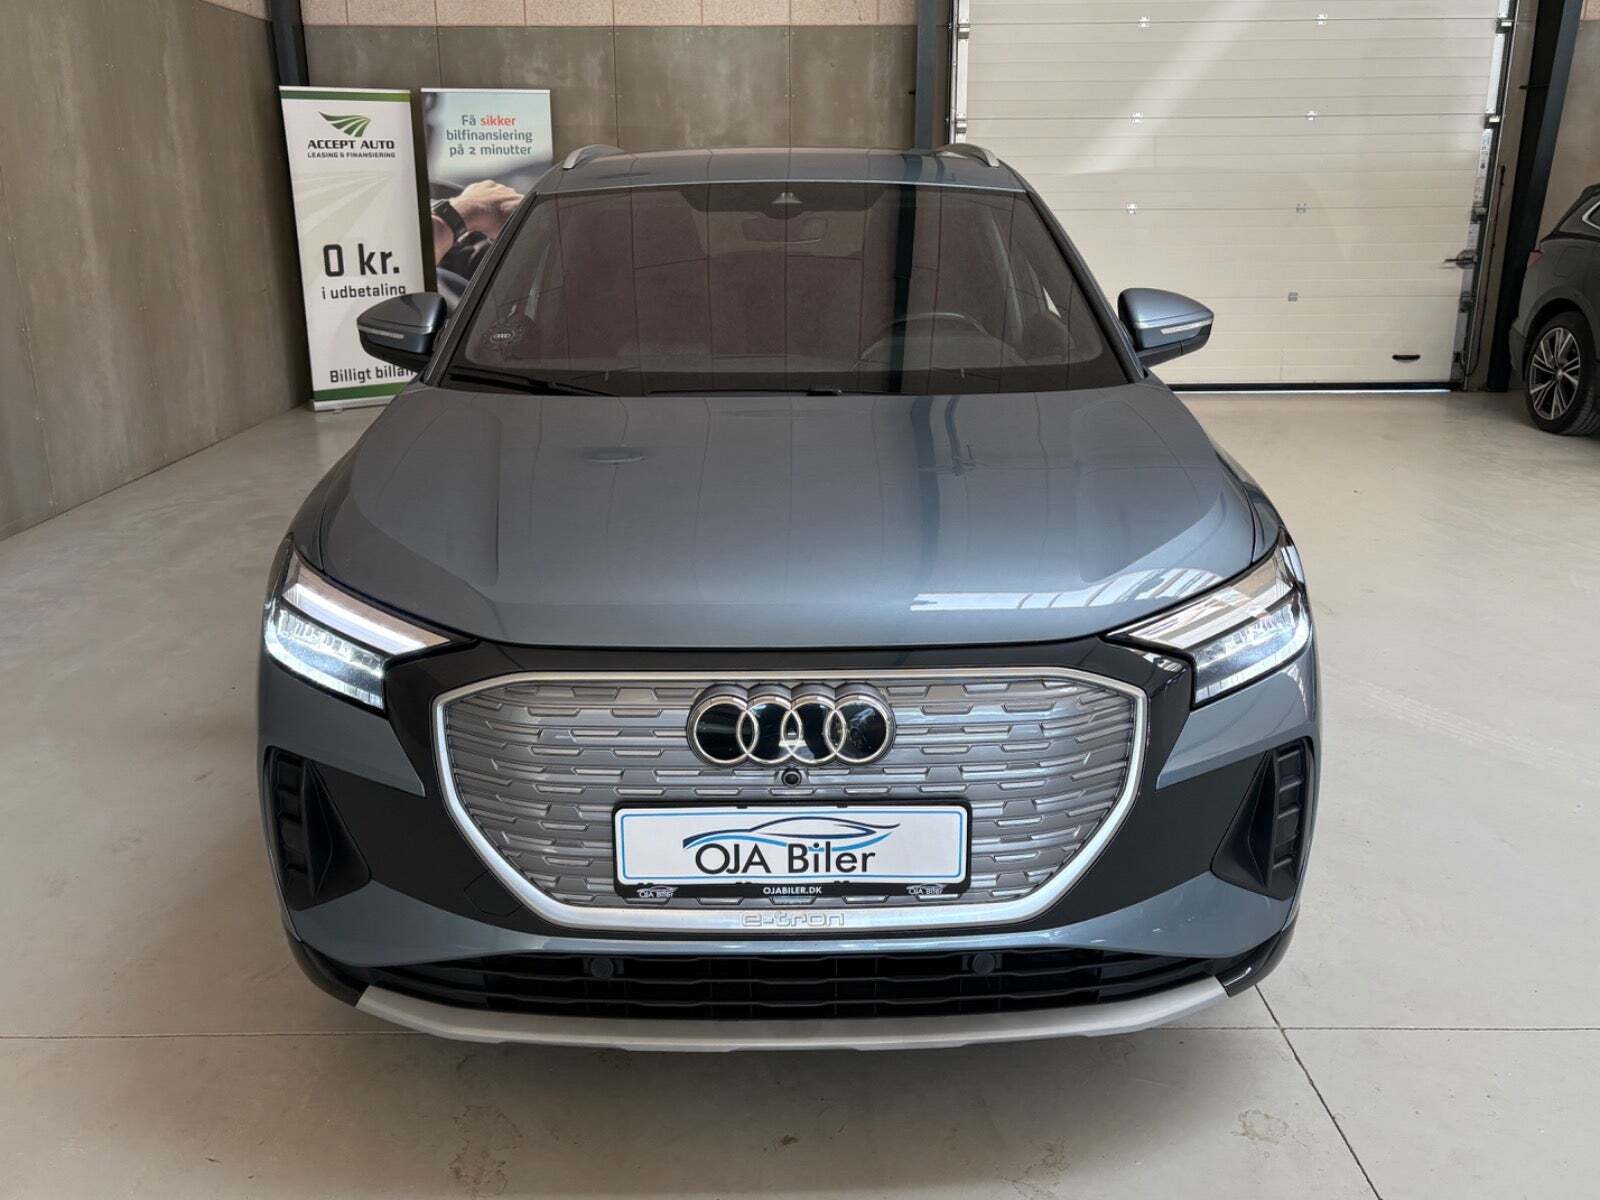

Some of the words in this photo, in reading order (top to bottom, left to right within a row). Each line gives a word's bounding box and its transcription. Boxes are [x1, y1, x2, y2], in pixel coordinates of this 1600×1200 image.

[461, 113, 477, 126] Få
[480, 114, 516, 126] sikker
[446, 129, 533, 143] bilfinansiering
[307, 139, 356, 150] ACCEPT
[360, 139, 395, 150] AUTO
[449, 143, 465, 157] på
[468, 146, 477, 155] 2
[480, 143, 532, 156] minutter
[307, 151, 339, 159] LEASING
[346, 151, 396, 159] FINANSIERING
[357, 242, 400, 276] kr.
[321, 286, 326, 300] i
[329, 367, 372, 384] Billigt
[695, 842, 772, 875] OJA
[787, 841, 876, 873] Biler
[762, 886, 823, 895] OJABILER.DK
[741, 911, 845, 927] e-tron
